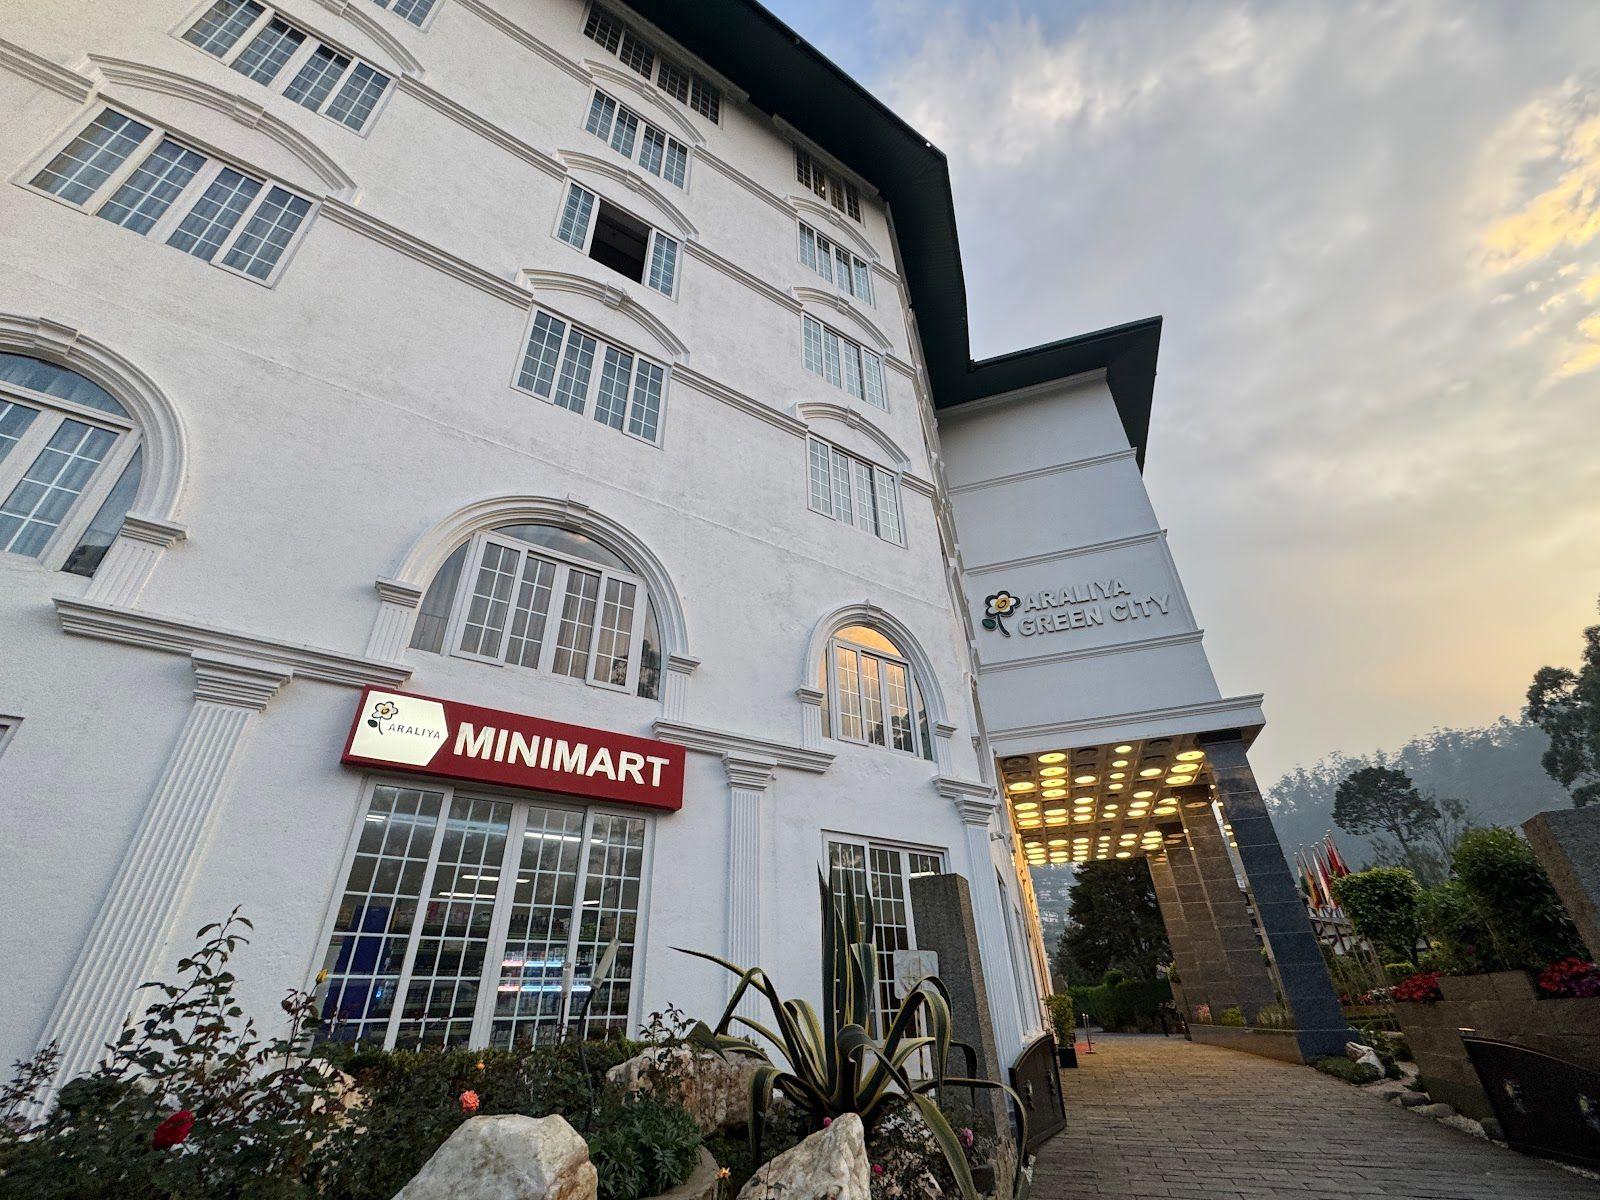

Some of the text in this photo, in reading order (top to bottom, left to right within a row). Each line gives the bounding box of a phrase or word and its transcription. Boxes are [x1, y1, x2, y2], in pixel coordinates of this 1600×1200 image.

[1024, 577, 1131, 613] ARALIYA
[1018, 594, 1171, 637] GREEN CITY
[388, 722, 441, 740] ARALIYA
[453, 721, 670, 787] MINIMART
